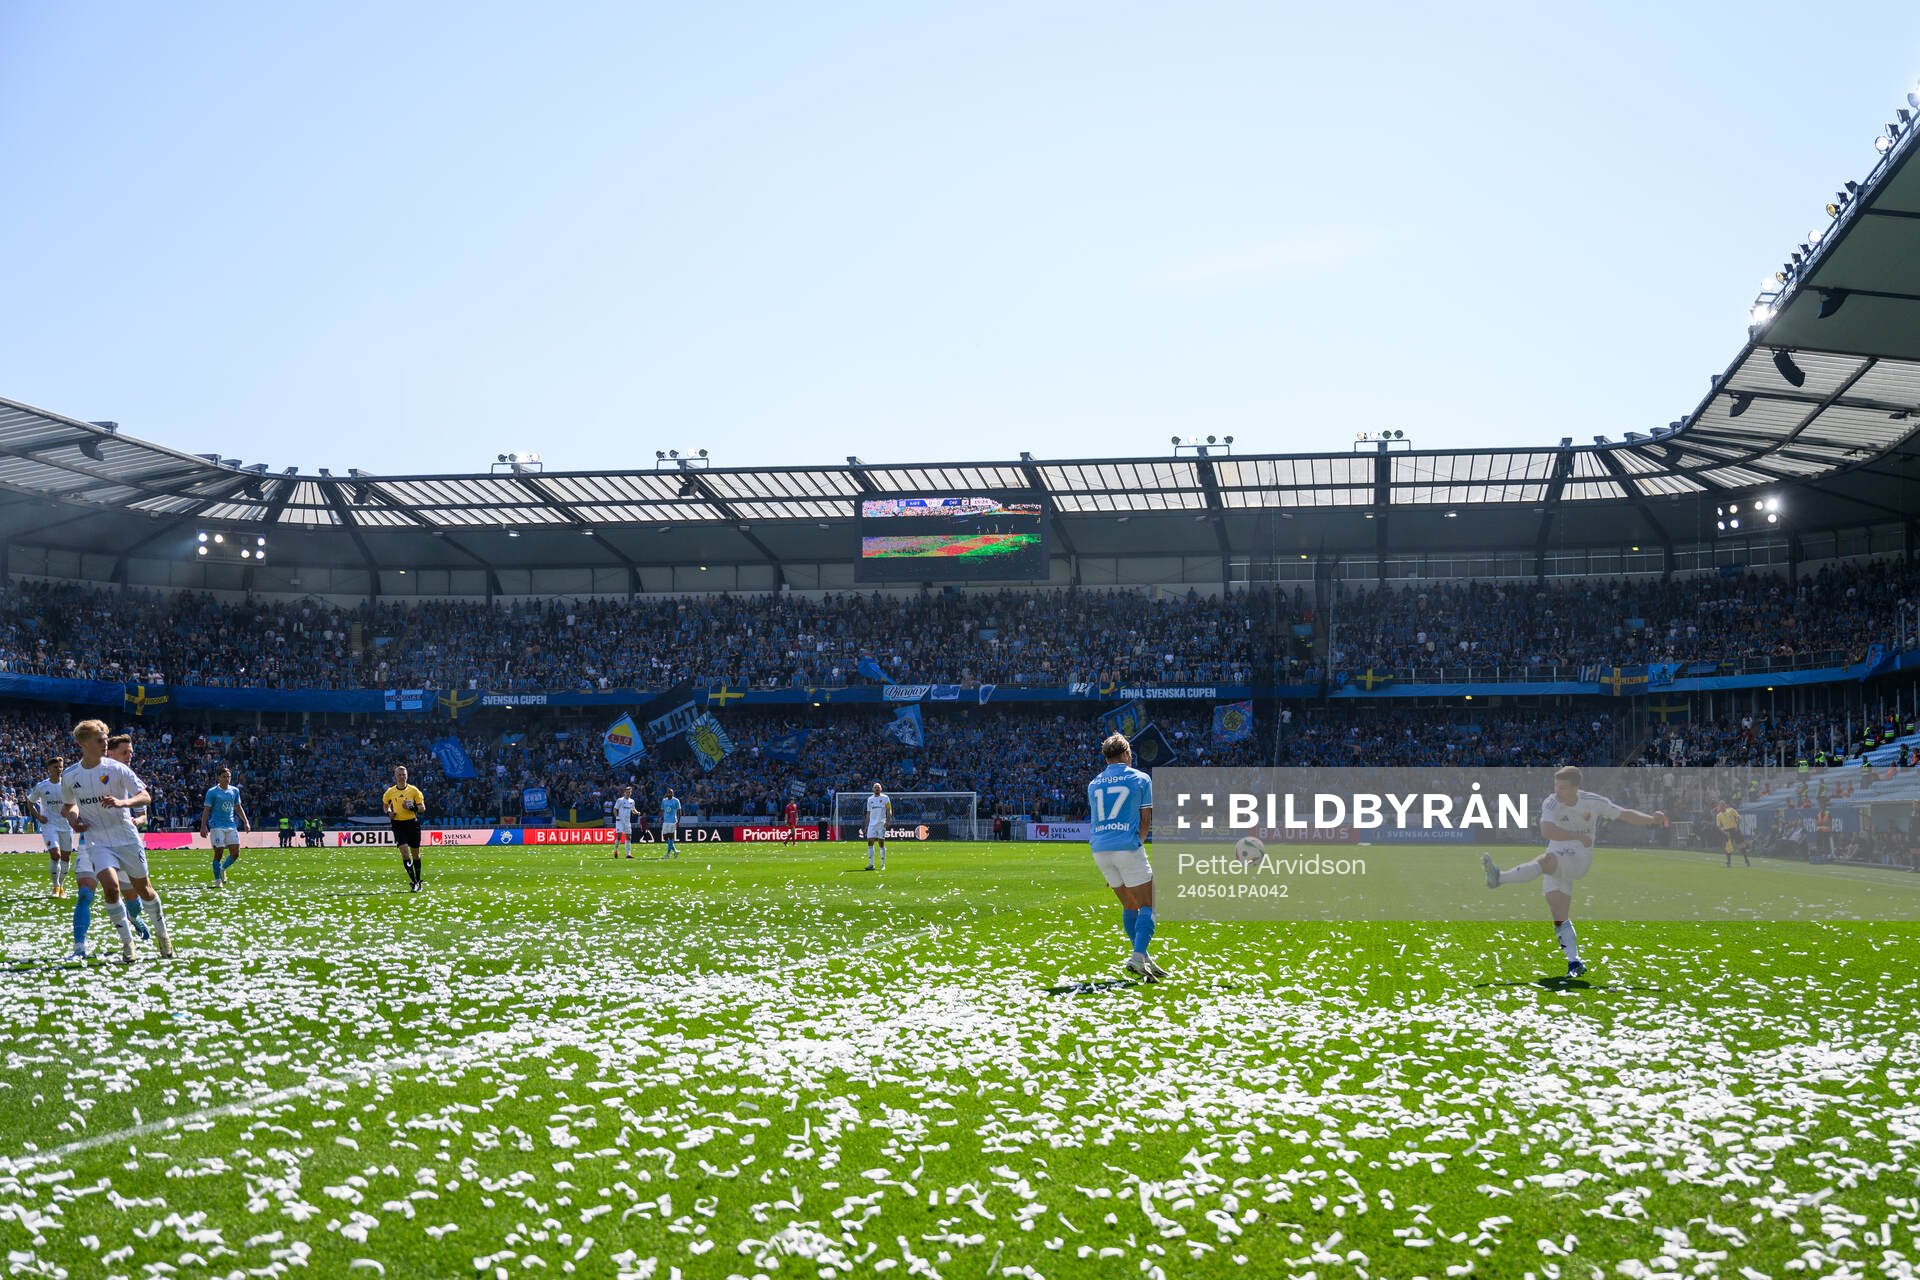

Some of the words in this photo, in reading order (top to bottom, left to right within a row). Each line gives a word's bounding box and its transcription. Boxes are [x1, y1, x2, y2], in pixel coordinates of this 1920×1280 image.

[1120, 688, 1144, 698] FINAL
[1146, 688, 1185, 698] SVENSKA
[1187, 687, 1216, 698] CUPEN
[482, 695, 519, 705] SVENSKA
[520, 695, 547, 705] CUPEN
[1094, 786, 1130, 821] 17
[338, 832, 396, 846] MOBIL
[537, 831, 615, 842] BAUHAUS
[1259, 828, 1349, 840] BAUHAUS
[1387, 831, 1429, 839] SVENSKA
